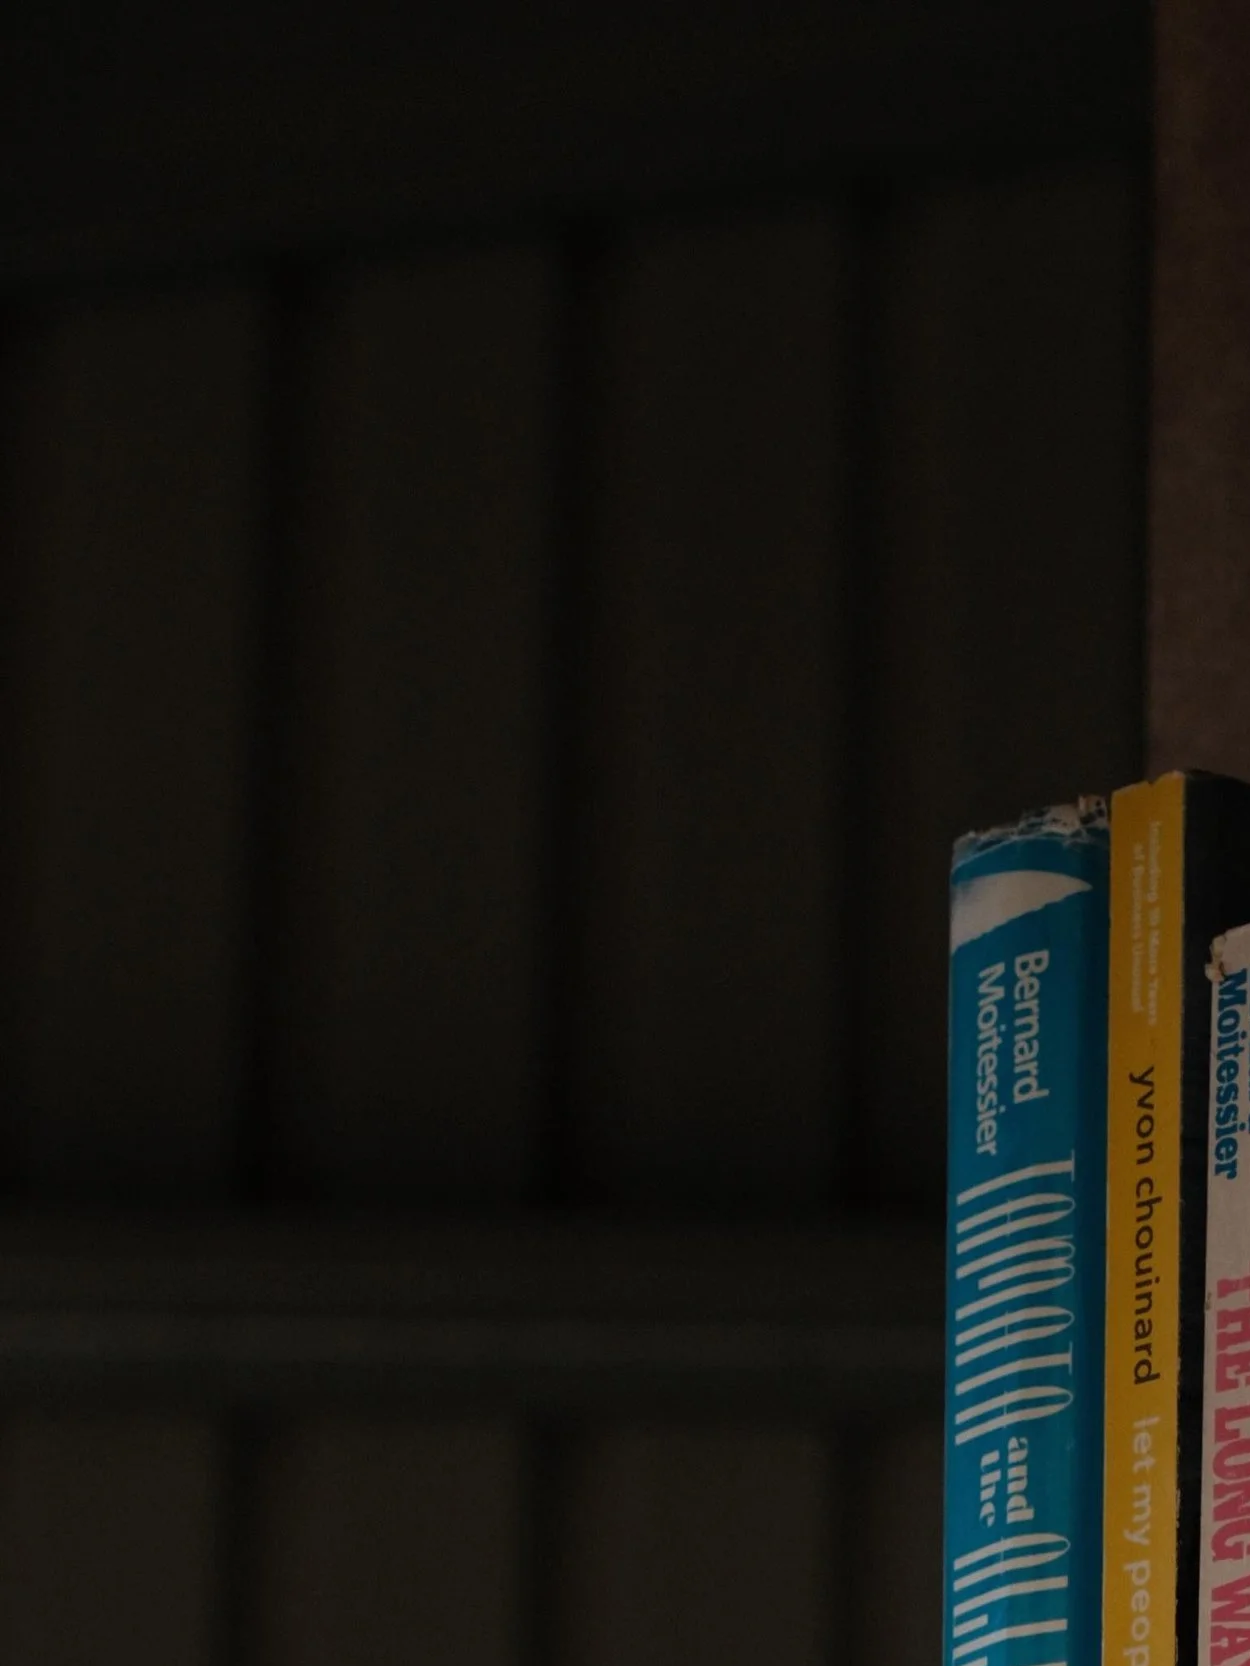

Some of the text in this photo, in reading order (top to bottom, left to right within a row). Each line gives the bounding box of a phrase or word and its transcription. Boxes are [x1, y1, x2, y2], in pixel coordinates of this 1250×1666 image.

[975, 961, 1005, 1157] Moitessier
[1012, 948, 1050, 1104] Bernard
[1214, 967, 1247, 1180] Moitessier
[1128, 1065, 1162, 1385] yvon chouinard
[979, 1448, 1000, 1528] the
[1005, 1436, 1035, 1524] and
[1132, 1415, 1161, 1471] let
[1122, 1483, 1152, 1546] my
